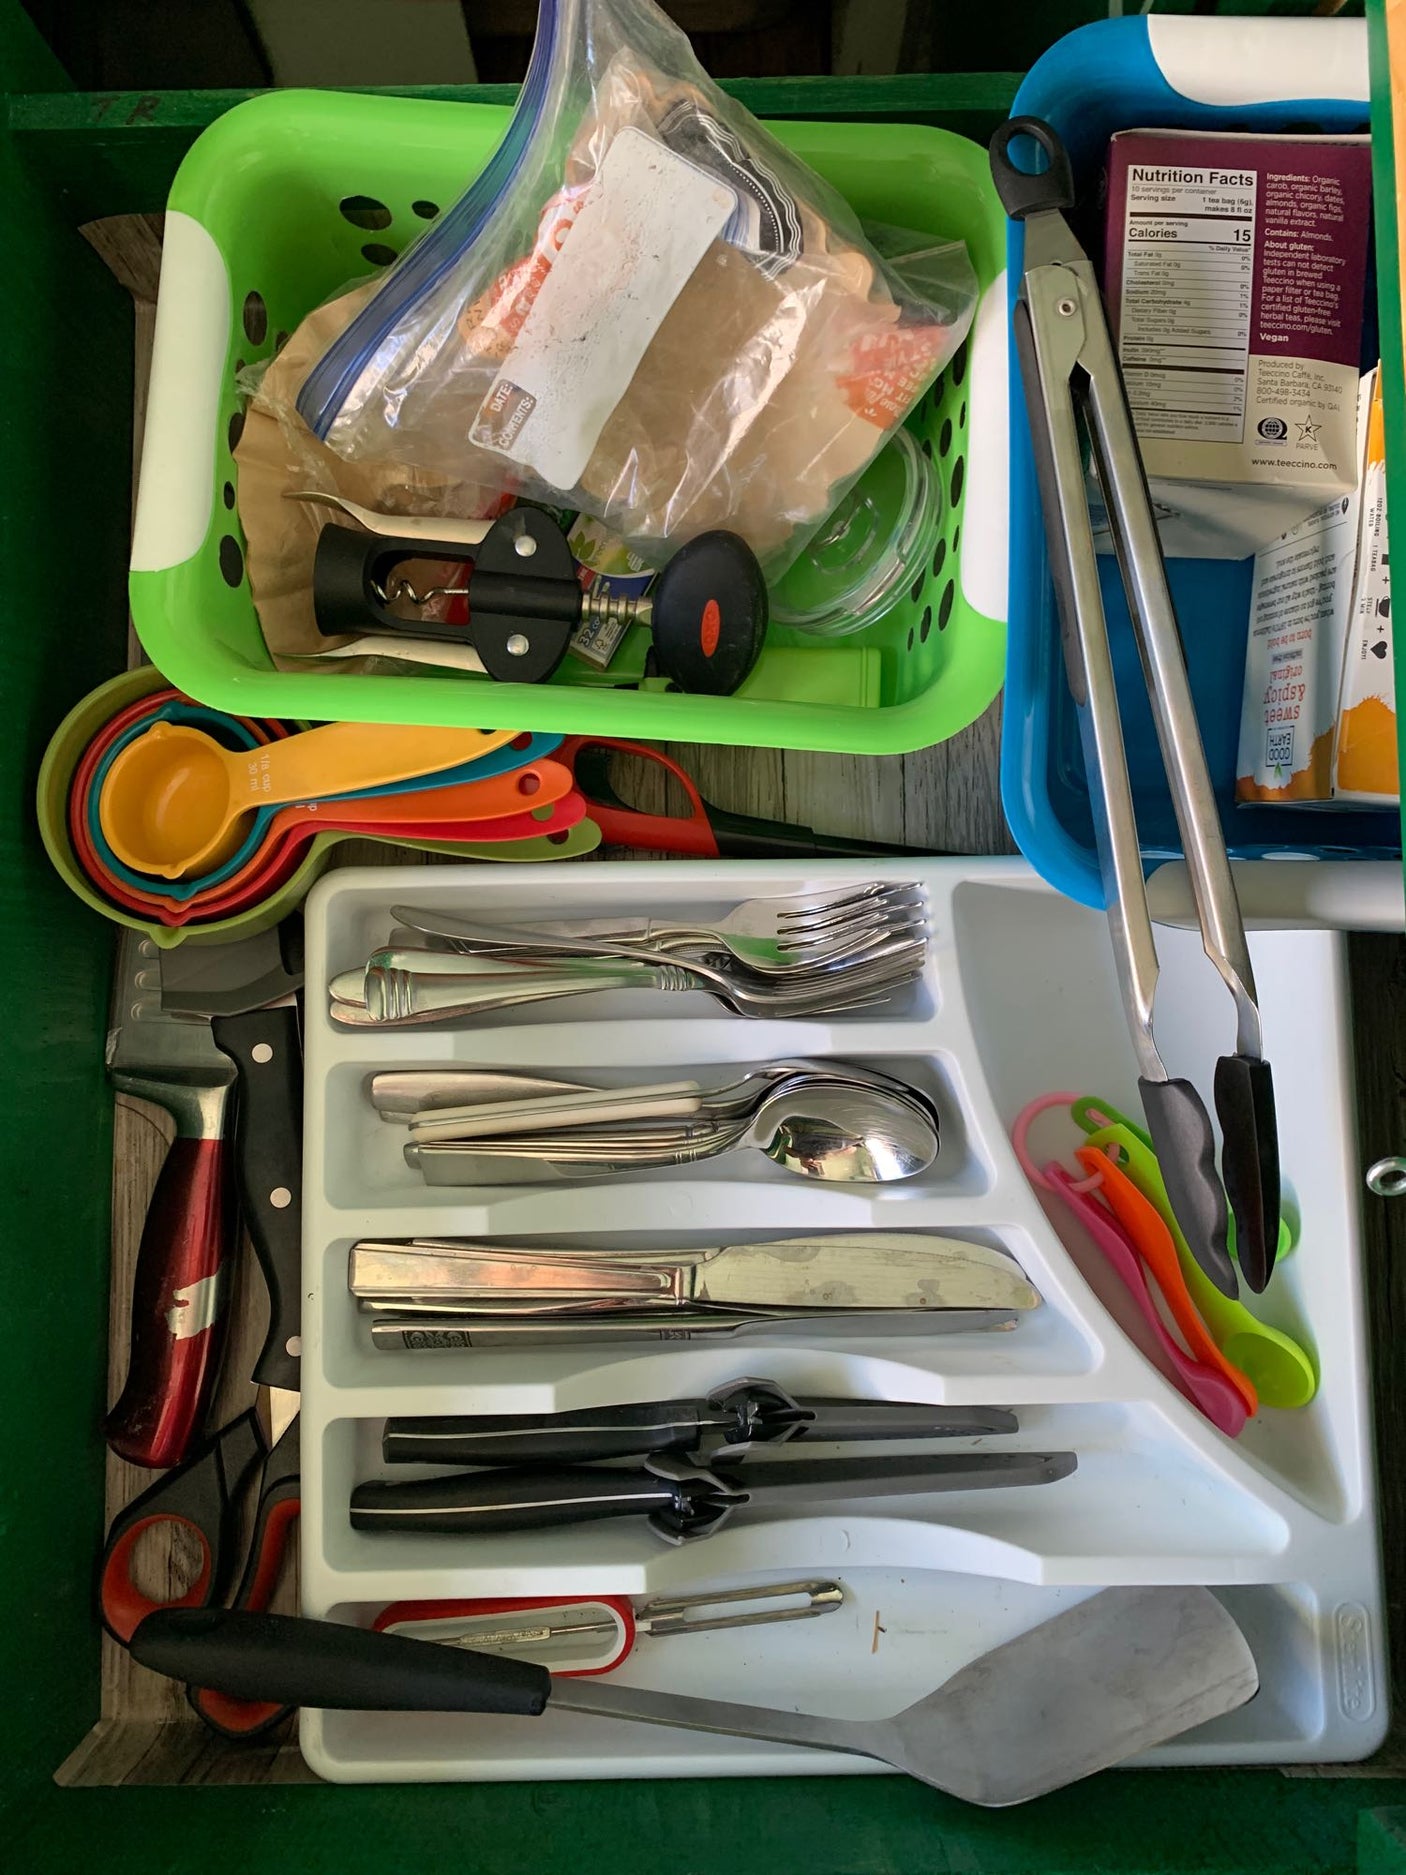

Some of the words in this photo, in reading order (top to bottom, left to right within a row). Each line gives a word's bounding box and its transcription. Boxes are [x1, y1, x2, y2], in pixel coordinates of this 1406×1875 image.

[1133, 169, 1203, 183] Nutrition
[1209, 172, 1253, 186] Facts
[1267, 173, 1311, 182] Ingredients:
[1312, 176, 1340, 186] Organic
[1291, 184, 1318, 192] organic
[1300, 202, 1326, 210] organic
[1293, 209, 1318, 218] flavors,
[1320, 213, 1344, 221] natural
[1129, 228, 1177, 238] Calories
[1234, 230, 1251, 242] 15
[1265, 228, 1298, 237] Contains:
[1301, 231, 1333, 241] Almonds.
[1264, 241, 1287, 249] About
[1289, 243, 1314, 251] gluten:
[1311, 254, 1346, 265] laboratory
[1263, 268, 1285, 276] gluten
[1296, 270, 1323, 279] brewed
[1311, 263, 1333, 272] detect
[1263, 276, 1294, 285] Teeccino
[1317, 282, 1335, 291] using
[1262, 286, 1283, 294] paper
[1285, 286, 1301, 294] filter
[1261, 303, 1291, 311] certified
[1293, 306, 1331, 316] gluten-free
[1304, 316, 1326, 324] please
[1260, 333, 1289, 343] Vegan
[1259, 360, 1293, 368] Produced
[1259, 369, 1289, 377] Teeccino
[1280, 379, 1310, 388] Barbara,
[1257, 387, 1310, 396] 800-498-3434
[490, 384, 513, 412] DATE:
[1256, 396, 1287, 404] Certified
[1290, 399, 1316, 407] organic
[499, 397, 533, 448] CONTENTS:
[1296, 443, 1318, 451] PARVE
[1252, 458, 1337, 470] www.teeccino.com
[579, 628, 591, 646] 32
[1270, 665, 1303, 683] original
[1264, 683, 1305, 704] &spicy
[1265, 705, 1300, 725] sweet
[1269, 733, 1291, 746] EARTH
[1269, 747, 1290, 760] GOOD
[261, 754, 270, 770] 1/8
[248, 763, 258, 774] 30
[250, 779, 259, 791] ml
[262, 774, 271, 792] cup
